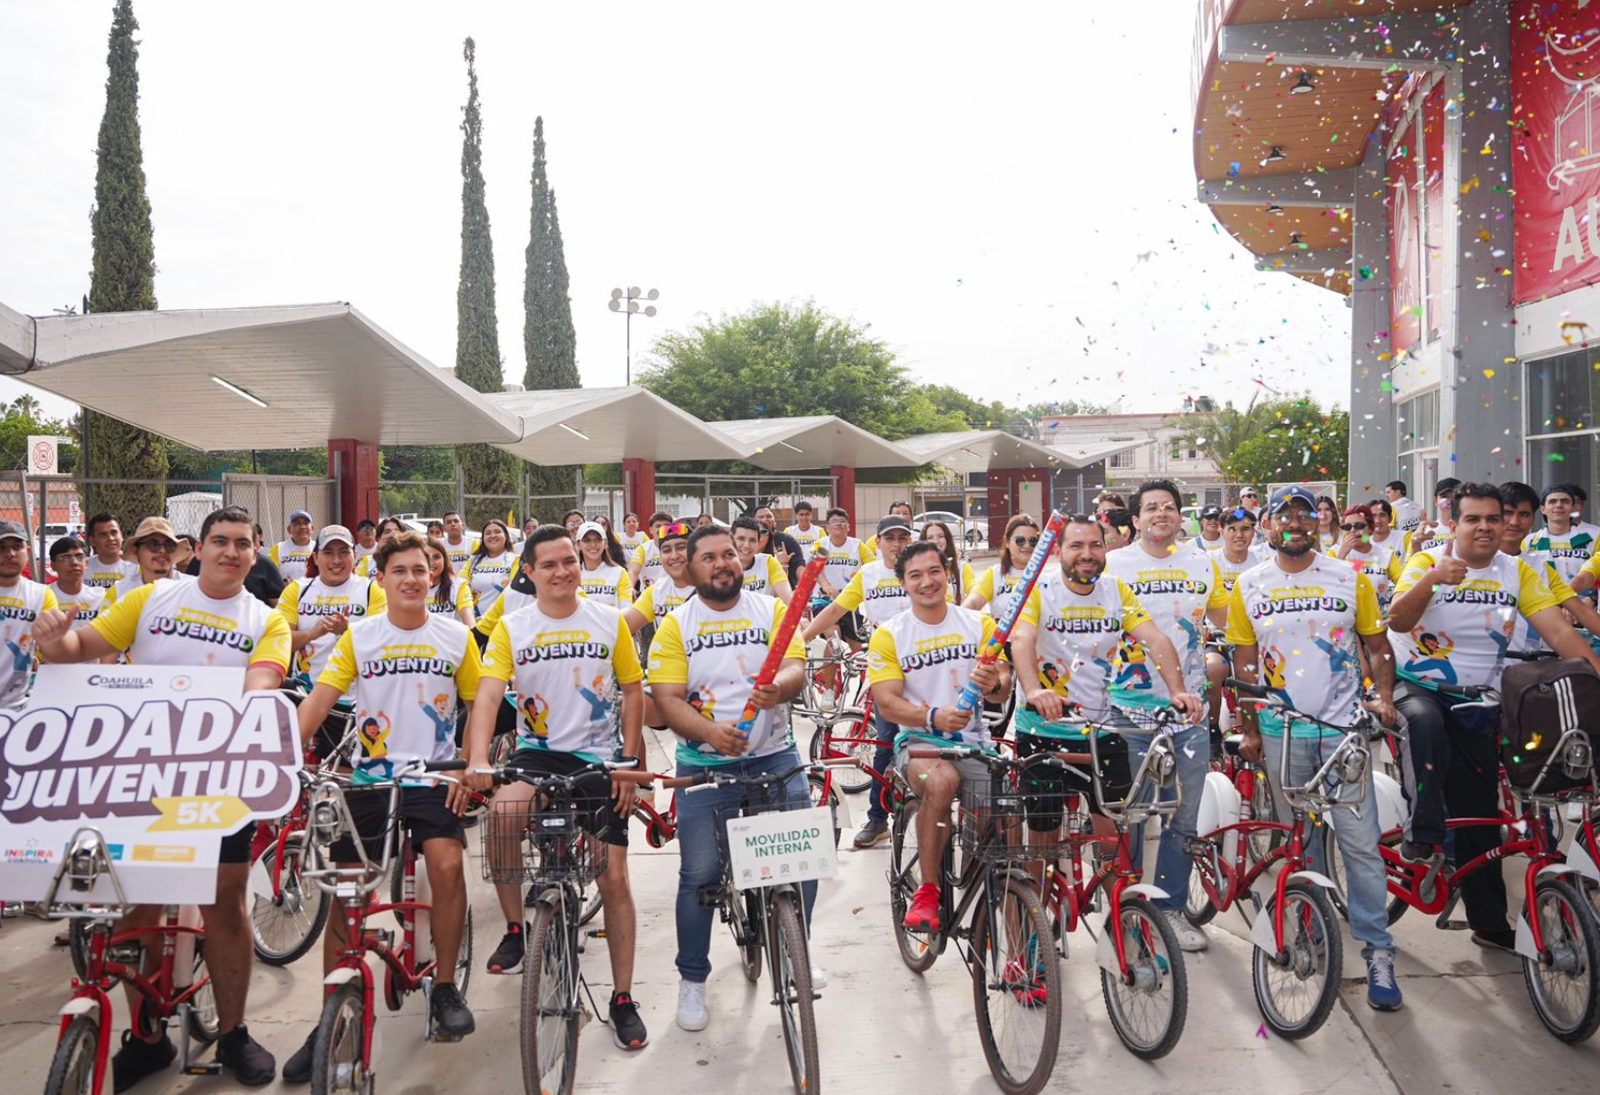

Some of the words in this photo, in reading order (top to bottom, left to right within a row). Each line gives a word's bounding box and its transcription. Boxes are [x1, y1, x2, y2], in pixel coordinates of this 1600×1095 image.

[1551, 548, 1590, 559] ENTUD
[580, 585, 616, 595] ENTUD
[865, 586, 907, 600] JUVENT
[1252, 597, 1348, 619] JUVENTUD
[149, 615, 254, 653] JUVENTUD
[516, 642, 609, 666] JUVENTUD
[361, 657, 454, 679] JUVENTUD
[87, 675, 154, 686] COAHUILA
[1, 759, 284, 815] JUVENTUD
[176, 801, 223, 826] 5K
[745, 828, 820, 847] MOVILIDAD
[755, 841, 812, 858] INTERNA
